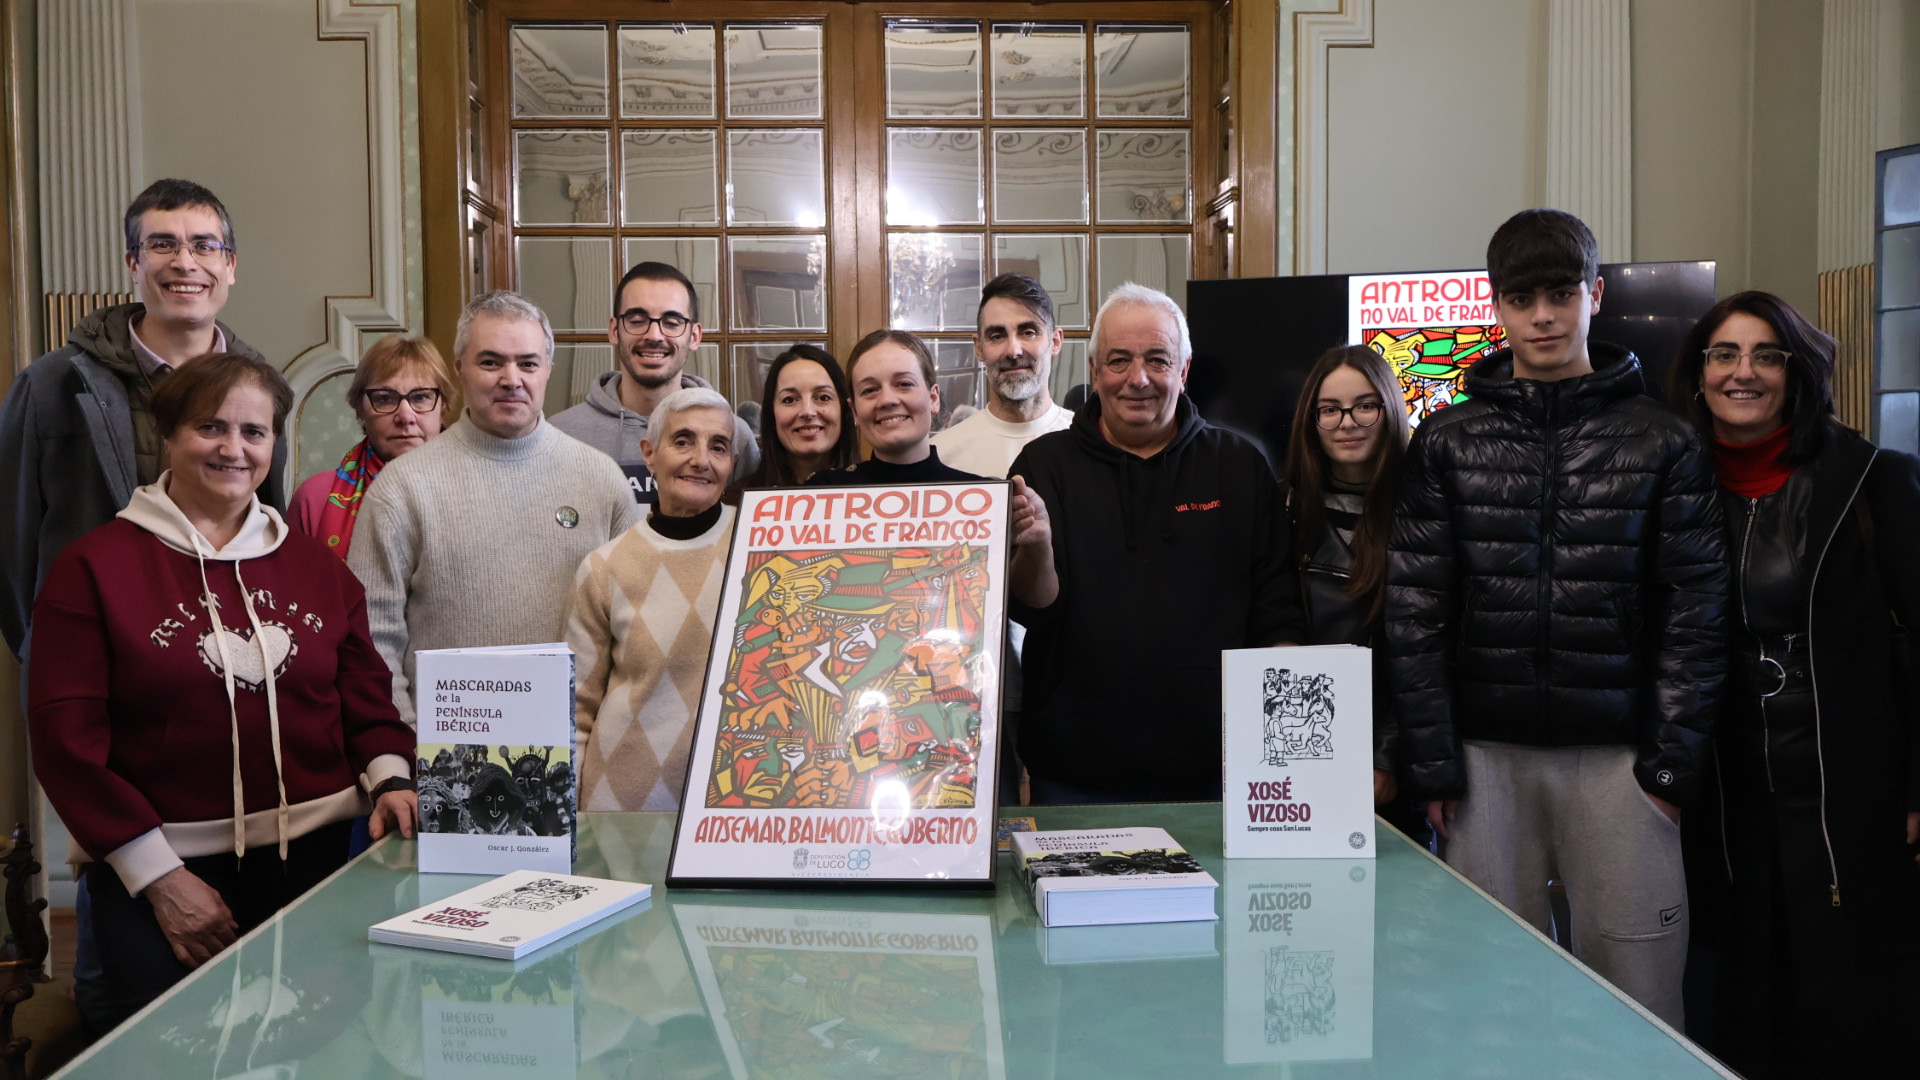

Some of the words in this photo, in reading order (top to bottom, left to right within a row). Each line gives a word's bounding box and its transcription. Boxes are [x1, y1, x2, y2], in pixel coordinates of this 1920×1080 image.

[1361, 308, 1383, 324] NO
[1387, 306, 1418, 323] VAL
[1424, 305, 1444, 322] DE
[753, 488, 992, 522] ANTROIDO
[1175, 504, 1189, 512] VAL
[748, 525, 784, 547] NO
[790, 524, 836, 544] VAL
[845, 522, 877, 543] DE
[883, 519, 992, 542] FRANCOS
[435, 680, 532, 693] MASCARADAS
[436, 693, 448, 703] de
[451, 693, 461, 703] la
[435, 706, 502, 718] PENÍNSULA
[436, 719, 490, 733] IBÉRICA
[1247, 776, 1292, 800] XOSÉ
[1247, 803, 1311, 822] VIZOSO
[886, 816, 978, 845] GOBERNO
[1247, 825, 1269, 833] Sempre
[516, 845, 550, 853] González
[817, 860, 846, 869] LUGO
[435, 907, 491, 919] XOSÉ
[422, 913, 490, 928] VIZOSO
